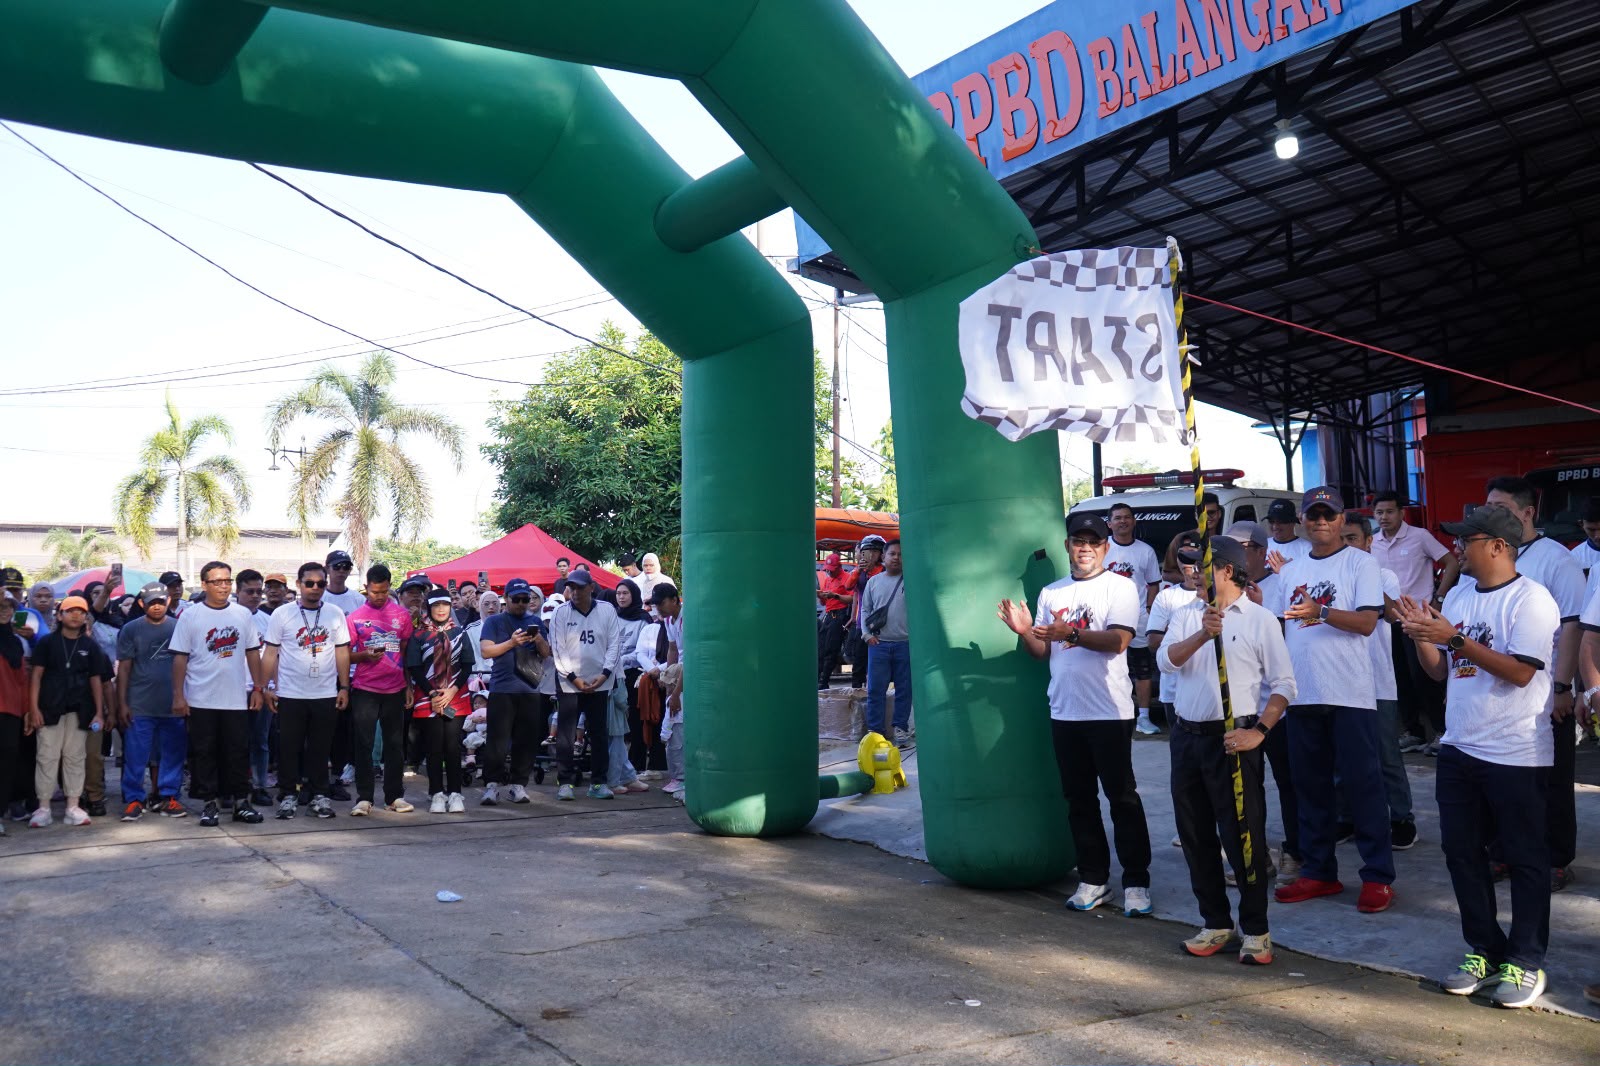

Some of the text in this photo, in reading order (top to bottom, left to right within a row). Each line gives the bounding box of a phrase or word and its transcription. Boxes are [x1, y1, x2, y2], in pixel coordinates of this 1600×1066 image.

[1088, 0, 1343, 119] BALANGA
[1558, 469, 1589, 481] BPBD
[211, 629, 235, 640] MAY
[580, 630, 595, 645] 45
